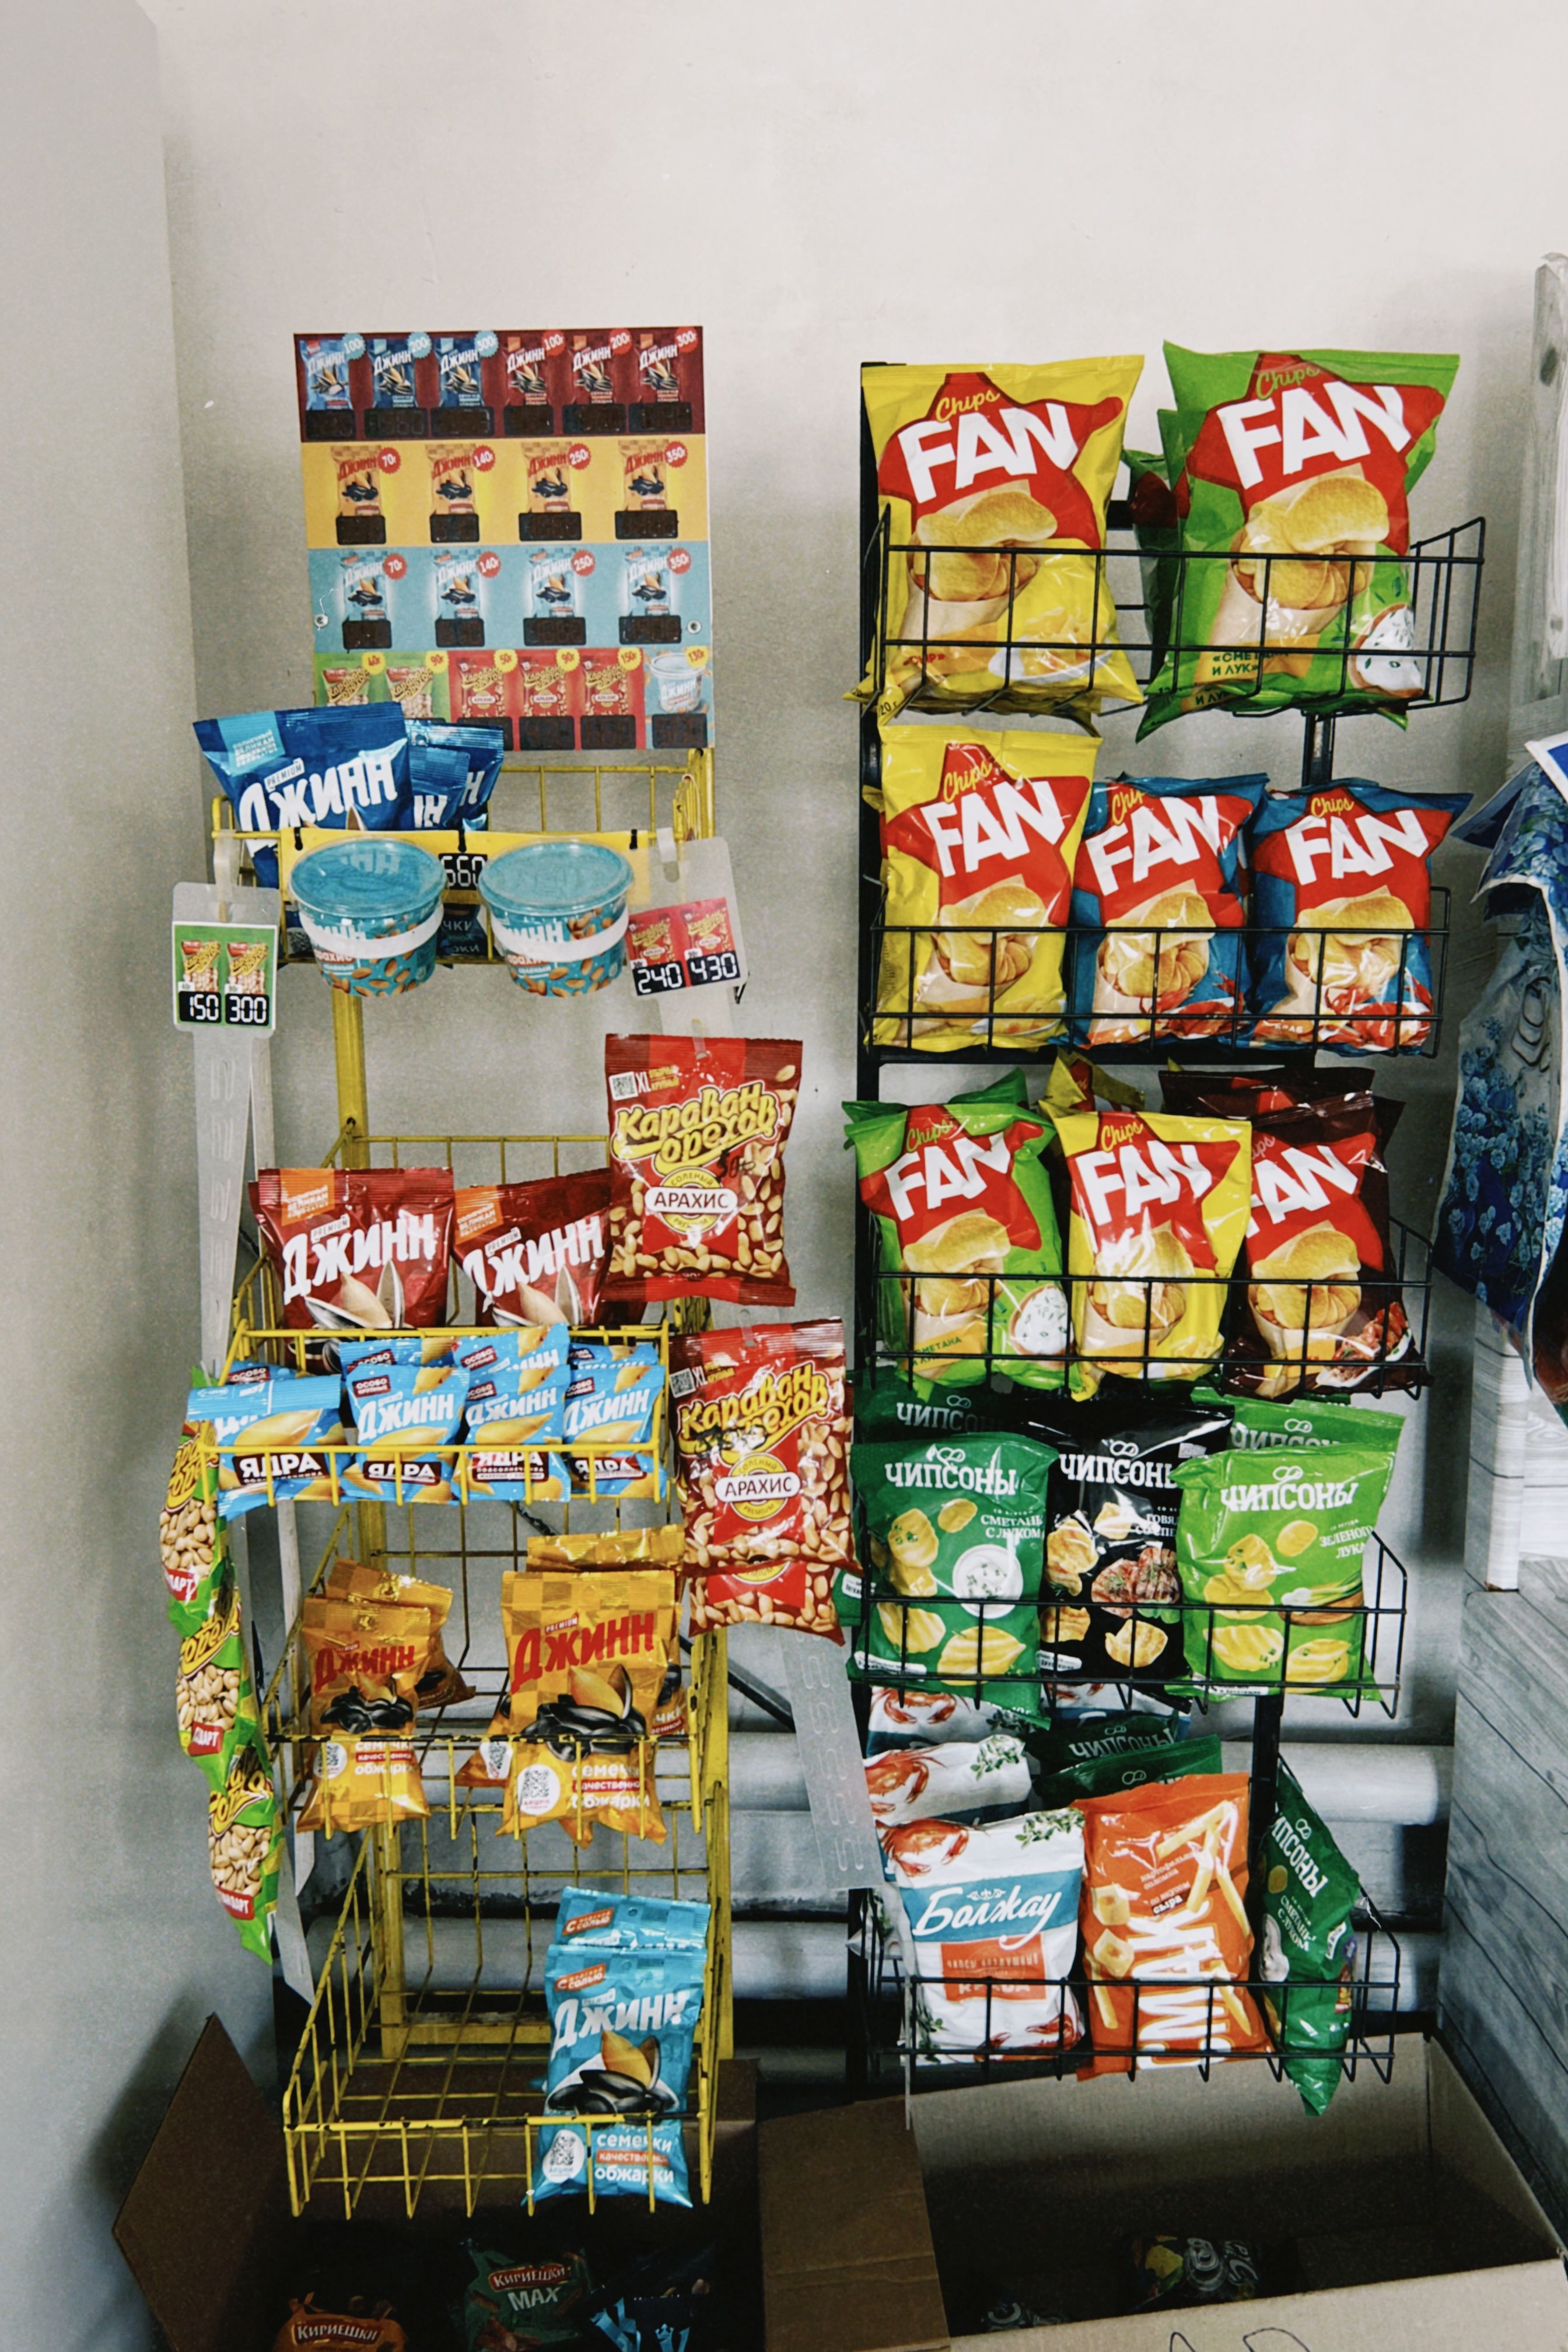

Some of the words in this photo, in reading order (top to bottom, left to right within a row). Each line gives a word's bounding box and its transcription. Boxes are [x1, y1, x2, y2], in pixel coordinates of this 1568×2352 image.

[1256, 365, 1320, 400] Chips
[936, 390, 1000, 423] Chips
[1217, 381, 1411, 489] FAN
[898, 402, 1078, 503] FAN
[266, 761, 303, 788] PREMIUM
[943, 761, 993, 803] Chips
[1311, 797, 1353, 818] Chips
[921, 781, 1066, 878] FAN
[1086, 796, 1227, 897] FAN
[1285, 810, 1429, 886] FAN
[638, 963, 682, 993] 240
[691, 953, 737, 980] 430
[190, 994, 219, 1021] 150
[229, 996, 267, 1023] 300
[1100, 1121, 1143, 1153] Chips
[884, 1133, 1011, 1222] FAN
[1075, 1140, 1213, 1227] FAN
[654, 1192, 729, 1209] АРАХИС
[724, 1476, 792, 1496] АРАХИС
[886, 1462, 1017, 1495] ЧИПСОНЫ
[1221, 1482, 1359, 1513] ЧИПСОНЫ
[986, 1527, 995, 1538] С
[509, 2288, 561, 2311] MAX
